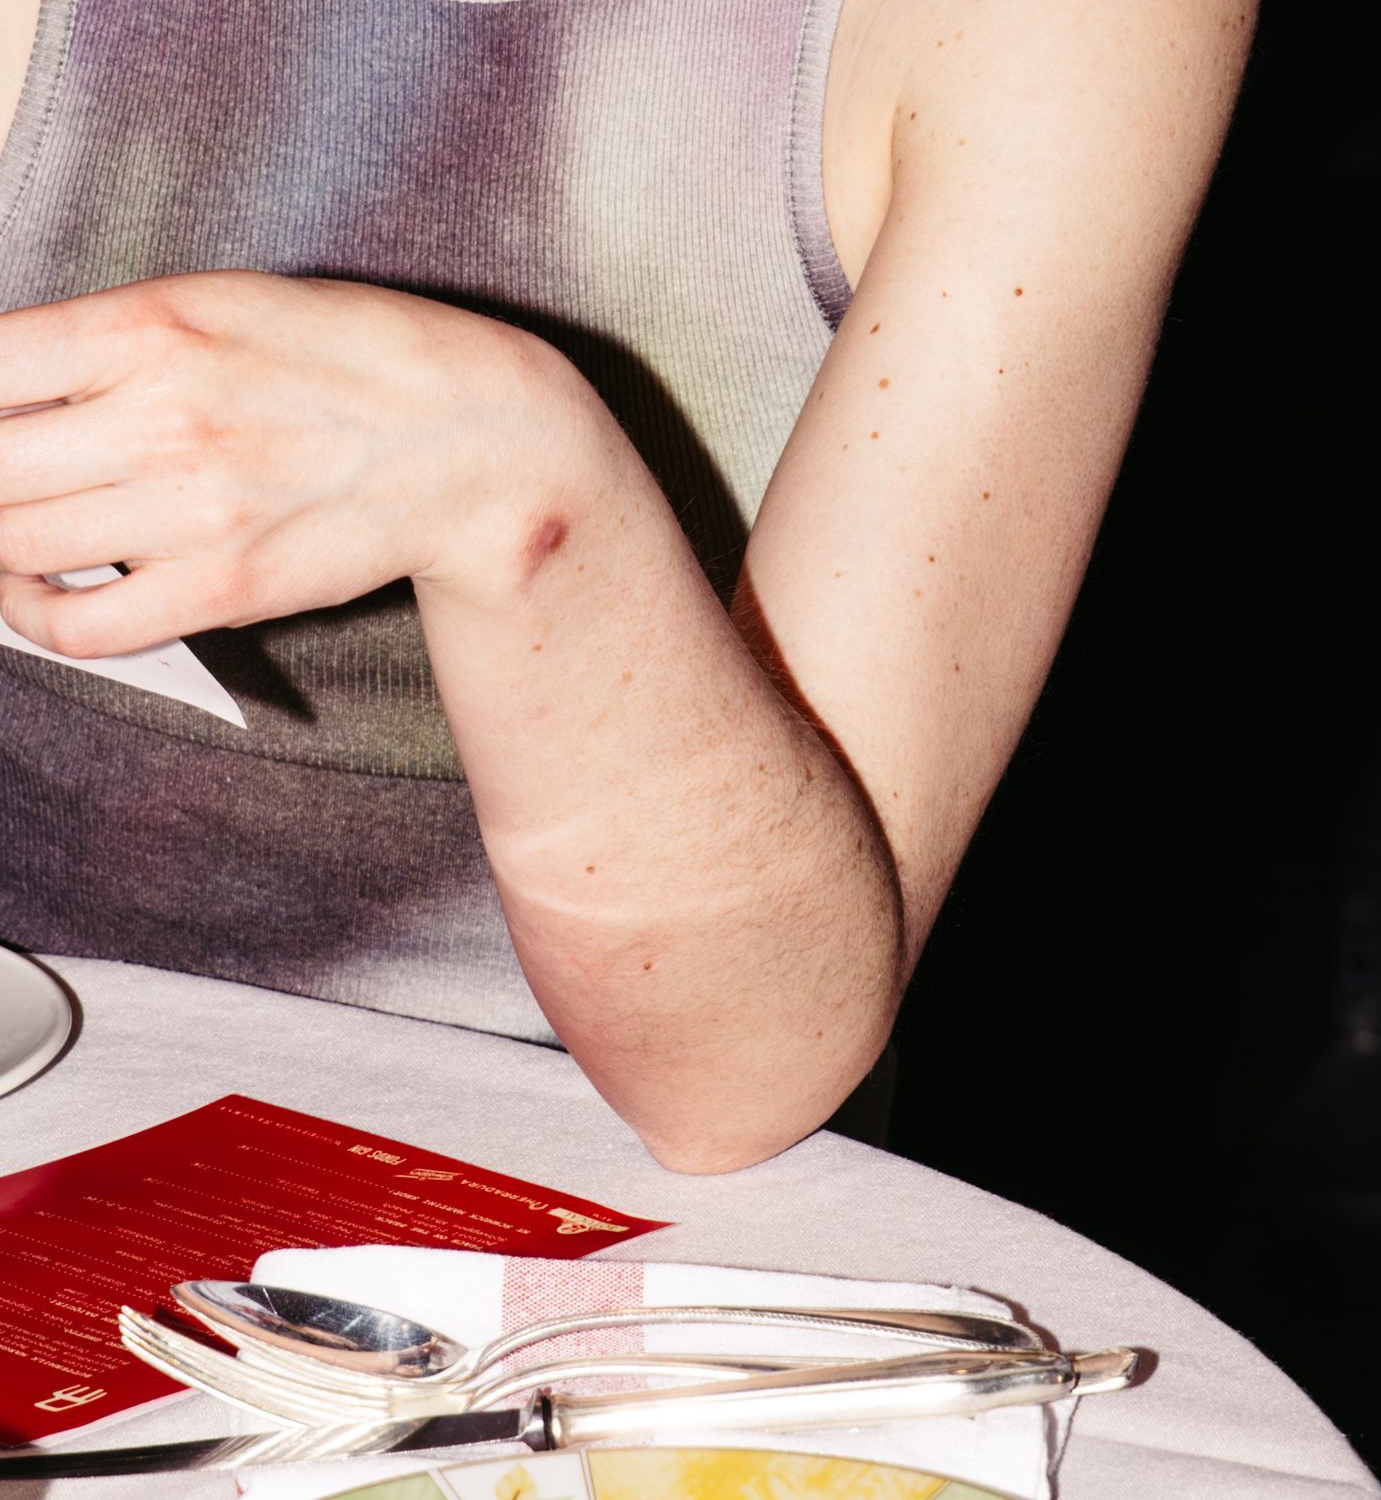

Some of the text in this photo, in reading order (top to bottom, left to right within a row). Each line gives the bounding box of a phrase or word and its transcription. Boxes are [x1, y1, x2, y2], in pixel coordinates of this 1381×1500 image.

[347, 1144, 407, 1166] FORDS GIN
[460, 1178, 535, 1206] HERRADURA
